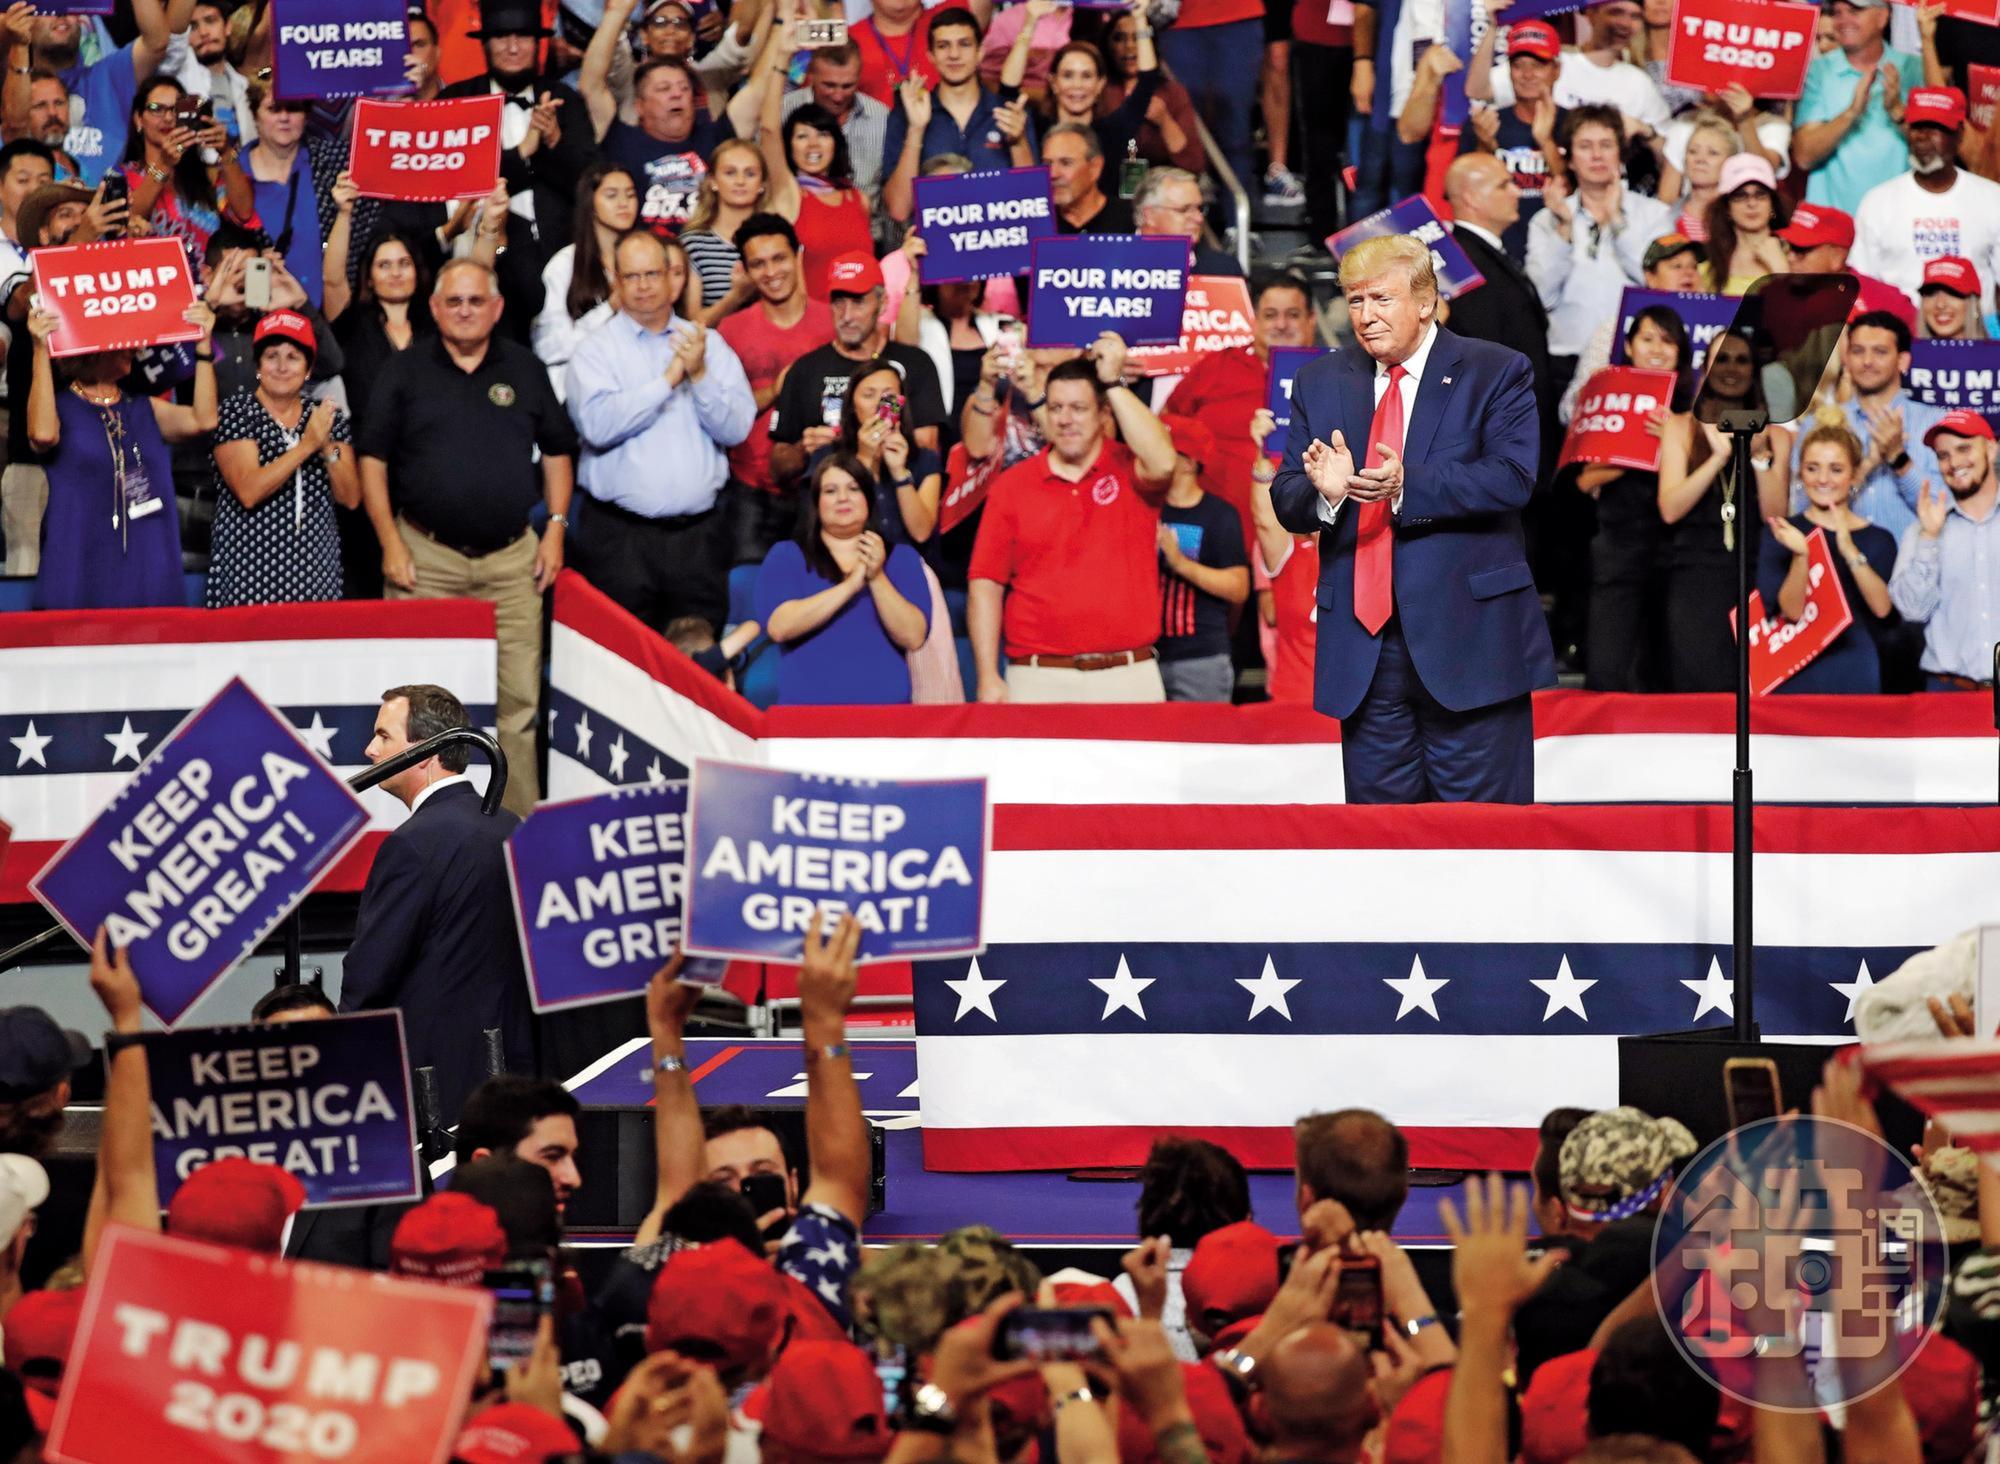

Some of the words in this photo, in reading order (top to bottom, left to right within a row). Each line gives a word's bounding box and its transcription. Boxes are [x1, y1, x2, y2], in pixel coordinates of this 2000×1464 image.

[281, 24, 340, 45] FOUR
[344, 20, 405, 42] MORE
[1682, 16, 1804, 50] TRUMP
[305, 48, 383, 70] YEARS!
[1703, 43, 1776, 71] 2020
[365, 125, 491, 150] TRUMP
[390, 151, 465, 171] 2020
[922, 203, 984, 229] FOUR
[987, 197, 1050, 222] MORE
[1913, 217, 1960, 230] FOUR
[950, 226, 1029, 252] YEARS!
[1914, 232, 1960, 243] MORE
[49, 266, 179, 297] TRUMP
[1037, 268, 1107, 290] FOUR
[1110, 268, 1182, 290] MORE
[82, 291, 158, 318] 2020
[1063, 296, 1153, 318] YEARS!
[1910, 367, 2000, 391] RUM
[108, 757, 213, 873] KEEP
[772, 795, 906, 844] KEEP
[104, 751, 311, 949] AMERICA
[589, 812, 688, 863] KEE
[702, 835, 973, 894] AMERICA
[166, 809, 316, 962] GREAT!
[742, 892, 929, 935] GREAT!
[191, 1044, 321, 1087] KEEP
[115, 1304, 441, 1407] TRUMP
[165, 1382, 360, 1459] 2020
